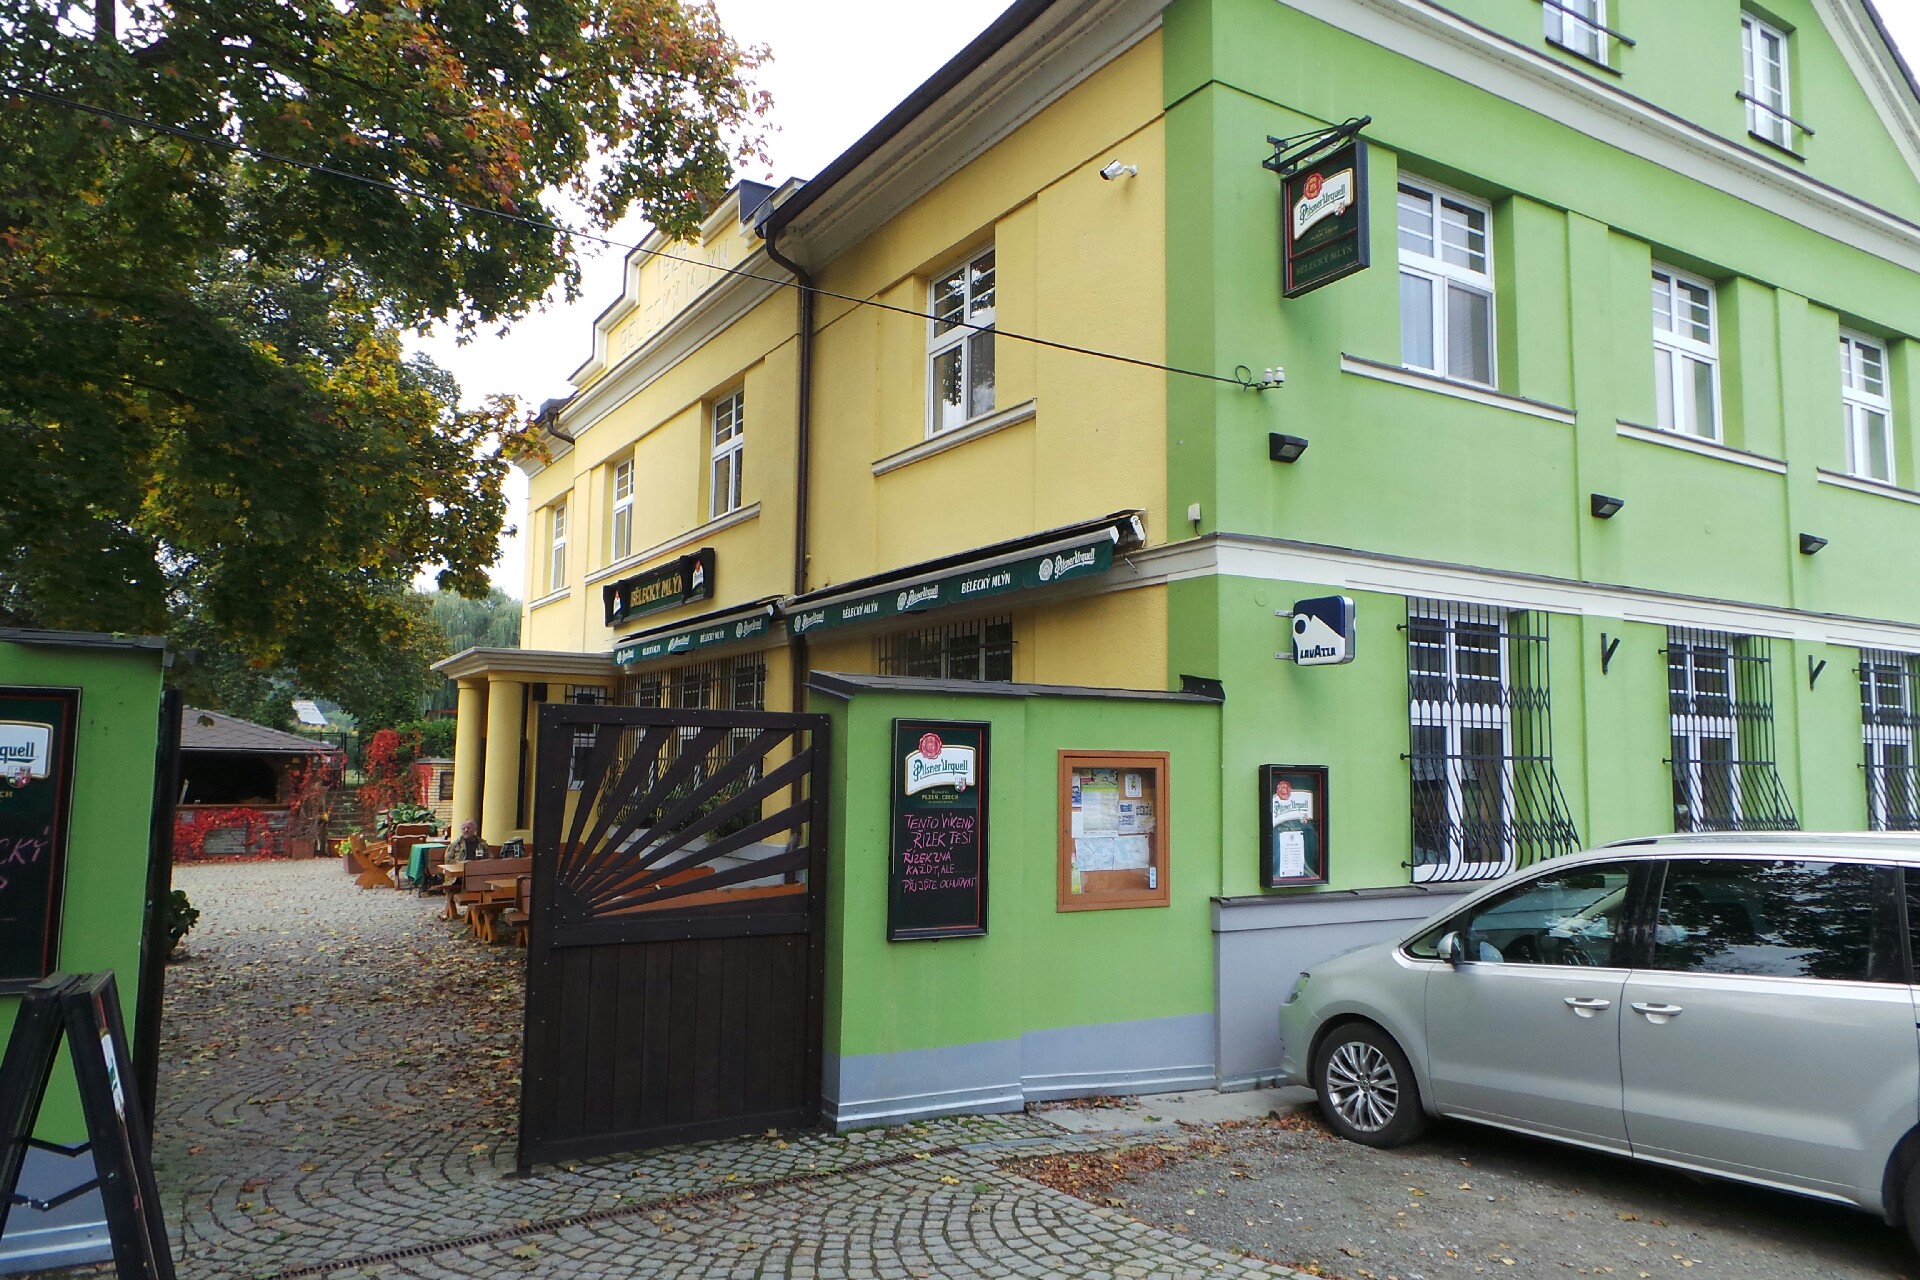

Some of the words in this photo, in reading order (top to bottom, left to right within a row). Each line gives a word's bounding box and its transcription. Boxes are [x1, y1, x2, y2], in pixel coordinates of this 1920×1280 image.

[1300, 198, 1323, 226] Pilsner
[1323, 183, 1346, 205] Urquell
[1054, 554, 1075, 580] Pilsner
[1075, 548, 1096, 567] Urquell
[991, 570, 1011, 588] MLÝN
[1300, 645, 1336, 659] LAVAZZA
[913, 758, 941, 782] Pilsner
[941, 758, 968, 776] Urquell
[904, 814, 939, 830] TENTO
[941, 812, 975, 831] VÍKEND
